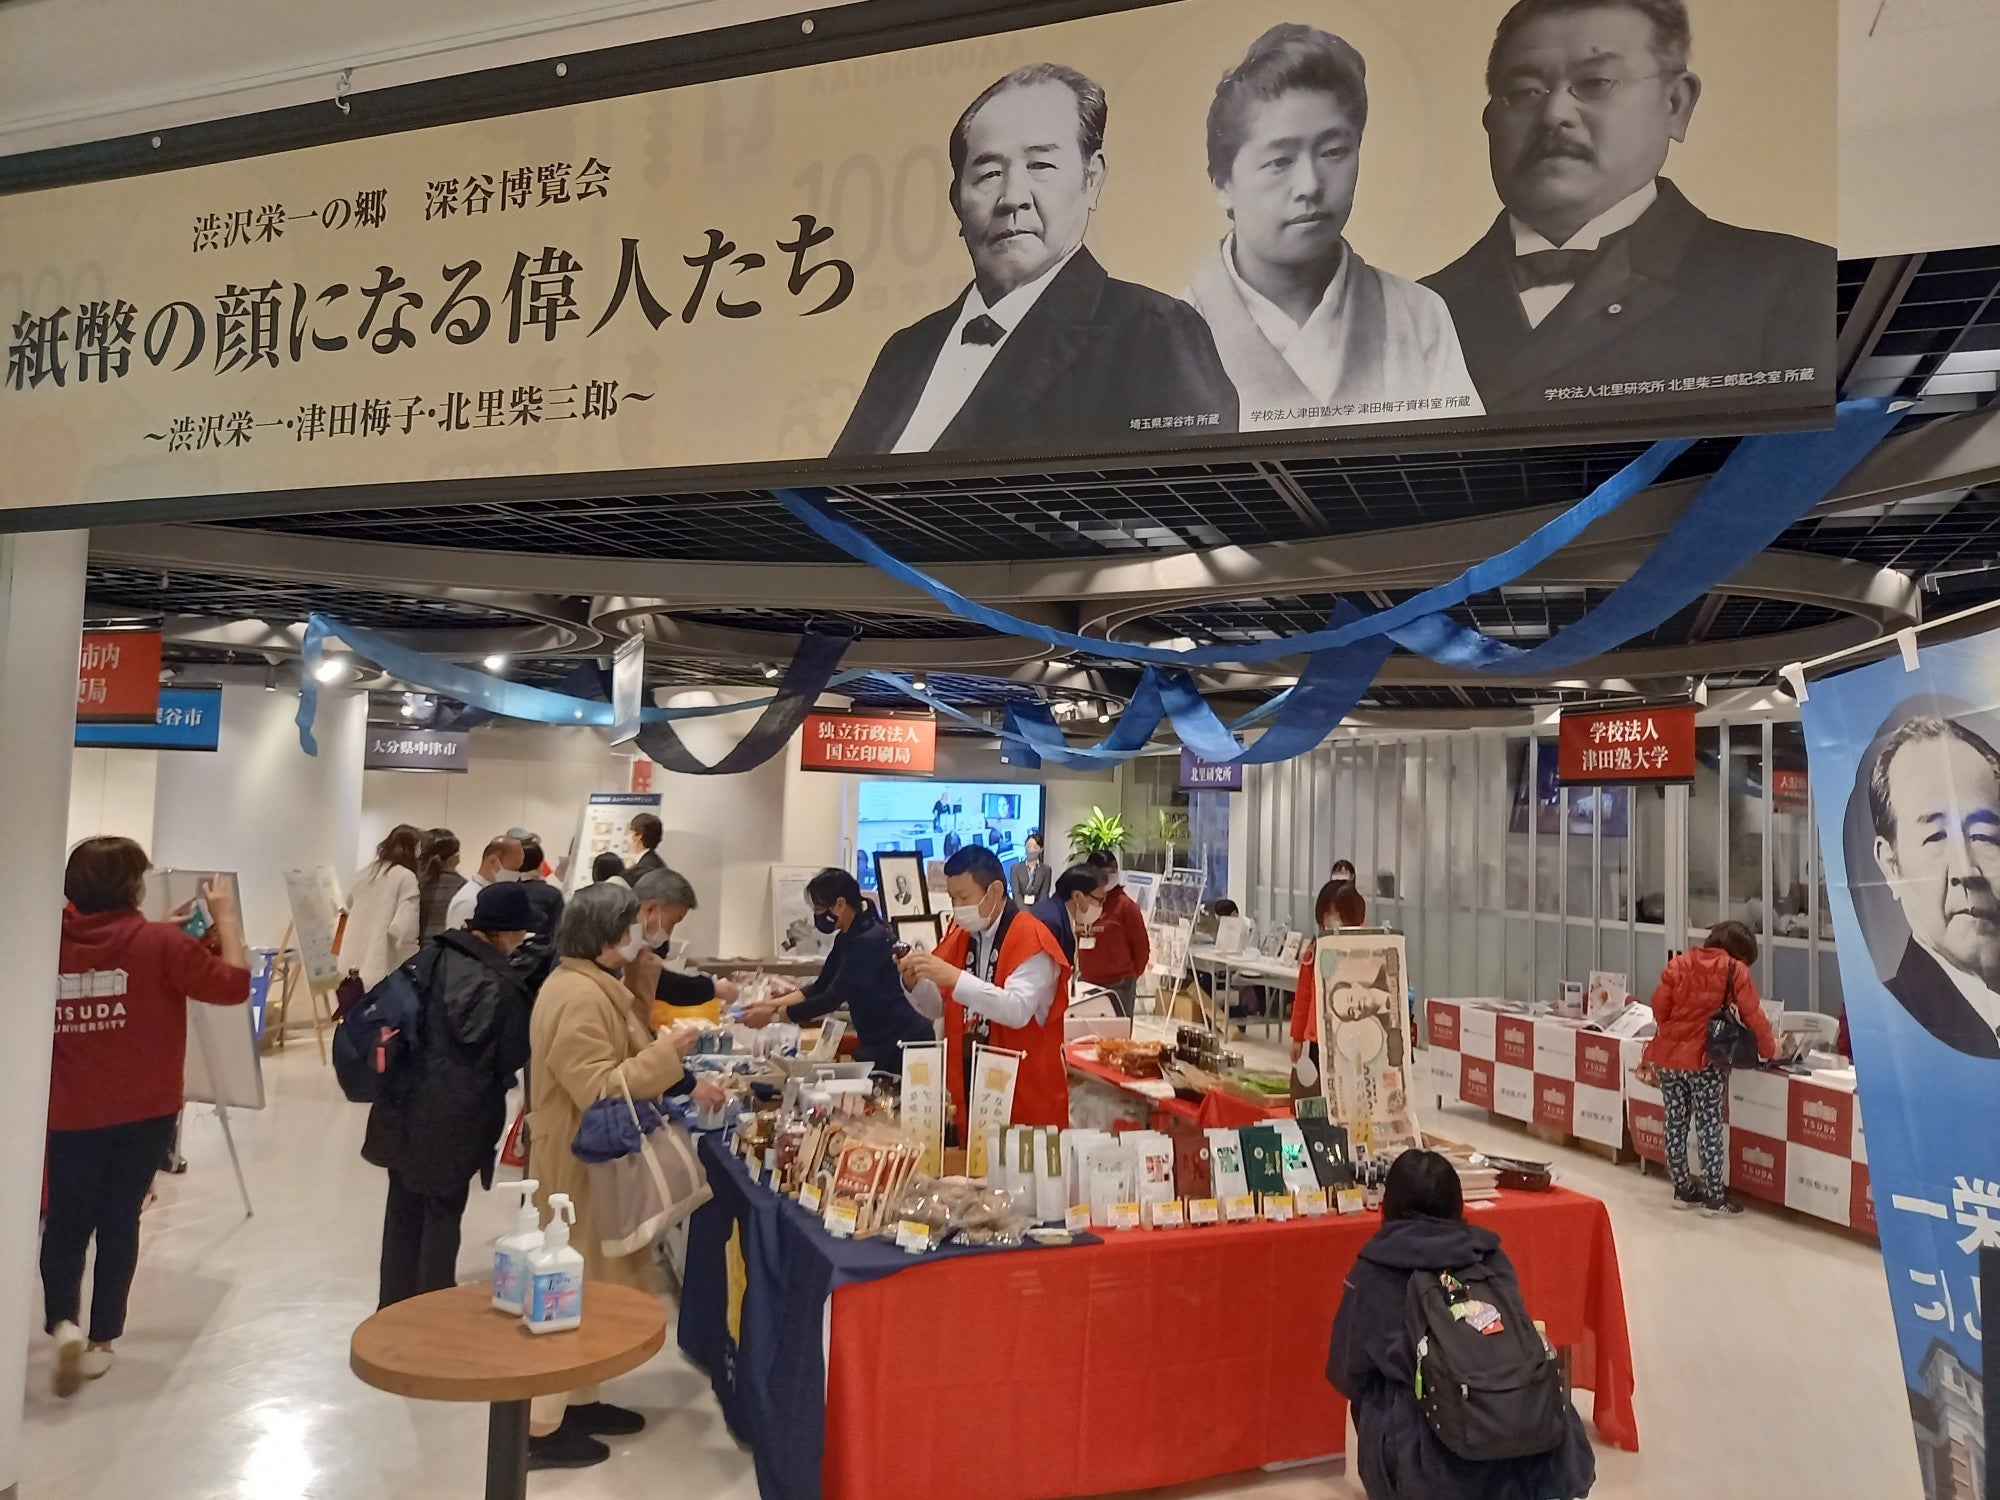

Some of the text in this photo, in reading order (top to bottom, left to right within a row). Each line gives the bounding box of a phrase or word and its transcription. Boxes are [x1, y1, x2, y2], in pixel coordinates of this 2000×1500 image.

[192, 156, 612, 253] 渋沢栄一の郷 深谷博覧会
[5, 214, 855, 391] 紙幣の顔になる偉人たち
[1544, 367, 1815, 401] 学校法人北里研究所 北里柴三郎記念室 所蔵
[1251, 395, 1471, 422] 学校法人津田塾大学 津田梅子資料室 所蔵
[1129, 413, 1220, 431] 埼玉県深谷市 所蔵
[818, 721, 920, 743] 独立行政法人
[1590, 717, 1659, 744] 学校法人
[372, 739, 457, 757] 大分県中津市
[826, 742, 911, 764] 国立印刷局
[1582, 745, 1669, 771] 津田塾大学
[1190, 766, 1232, 782] 北里研究所
